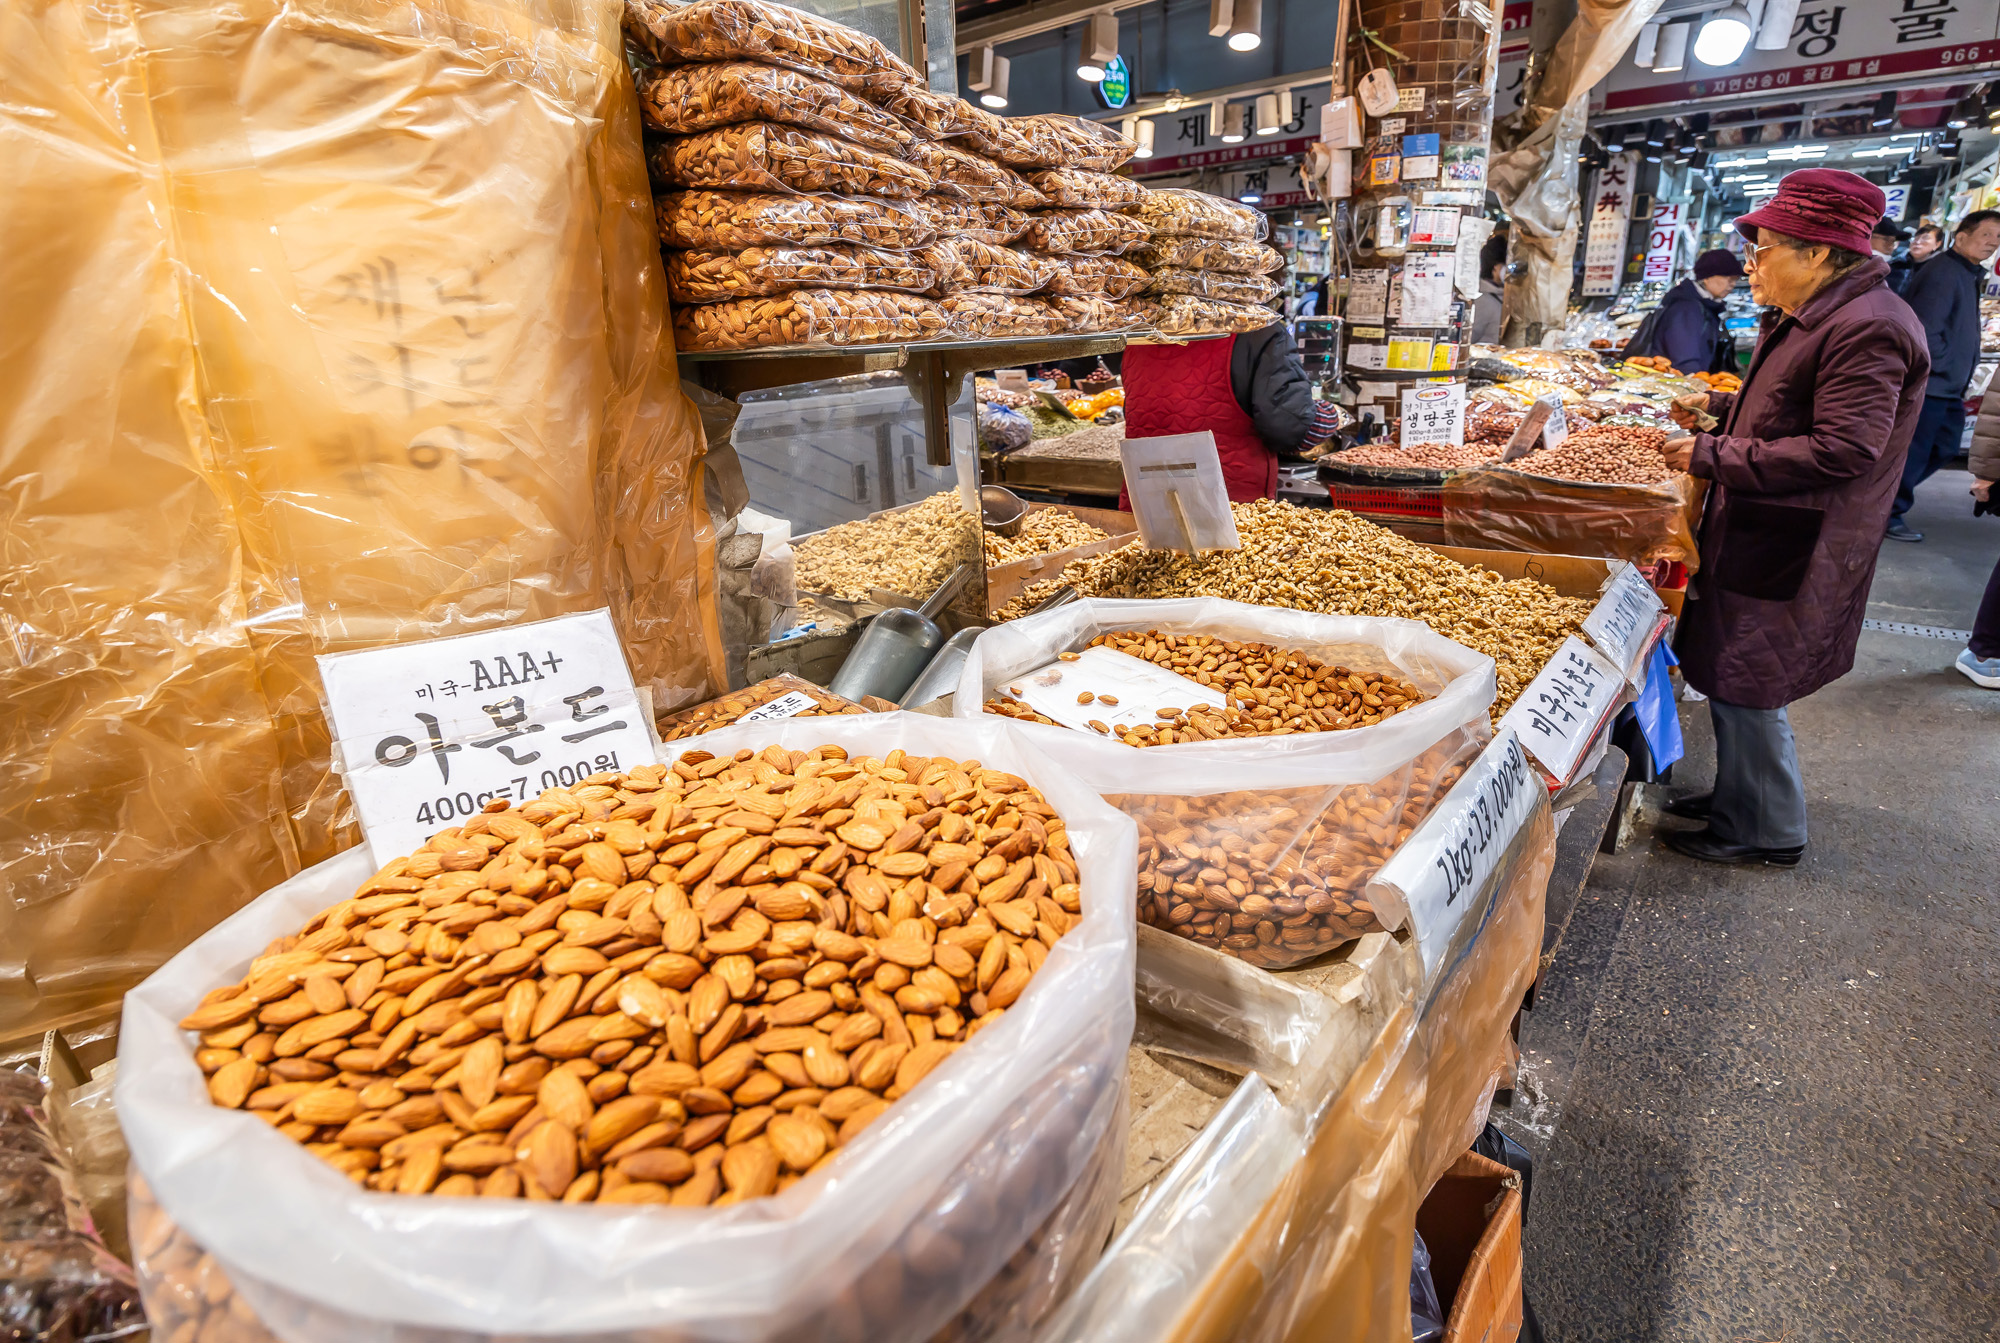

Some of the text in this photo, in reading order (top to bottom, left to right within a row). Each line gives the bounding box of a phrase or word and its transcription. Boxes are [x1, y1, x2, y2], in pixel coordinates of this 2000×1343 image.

[1940, 46, 1979, 65] 966
[1712, 71, 1791, 94] 자연산송이
[1847, 59, 1881, 76] 매실
[1646, 203, 1679, 276] 건어물
[1405, 409, 1457, 428] 생땅콩
[750, 697, 801, 720] 아몬드
[375, 685, 628, 786] 아몬드
